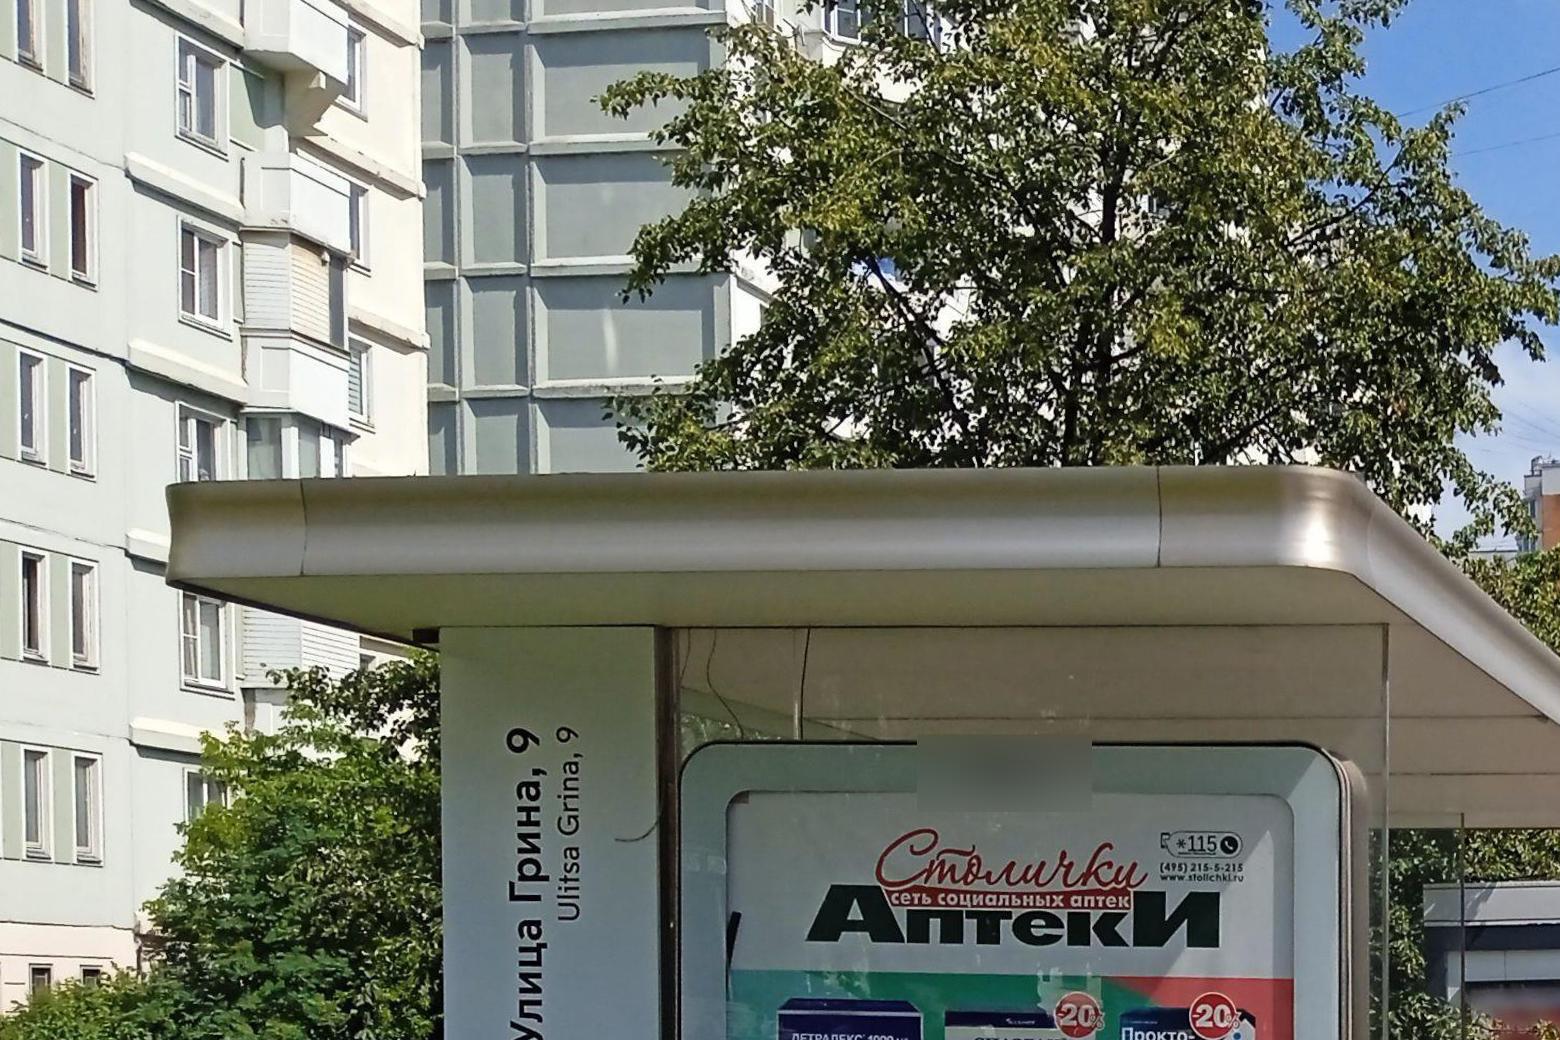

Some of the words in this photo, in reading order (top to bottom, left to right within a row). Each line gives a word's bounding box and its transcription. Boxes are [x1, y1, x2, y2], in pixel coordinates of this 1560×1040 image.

[506, 727, 541, 754] 9
[555, 726, 579, 743] 9
[556, 752, 584, 836] Grina,
[508, 767, 551, 903] Грина,
[875, 828, 1148, 889] Столички
[1160, 862, 1188, 874] (495)
[1190, 862, 1243, 873] 215-5-215
[556, 846, 581, 922] Ulitsa
[890, 892, 933, 906] сеть
[937, 891, 1065, 909] социальных
[1069, 893, 1131, 909] аптек
[1056, 1003, 1105, 1030] -20%
[1192, 1004, 1242, 1030] -20%
